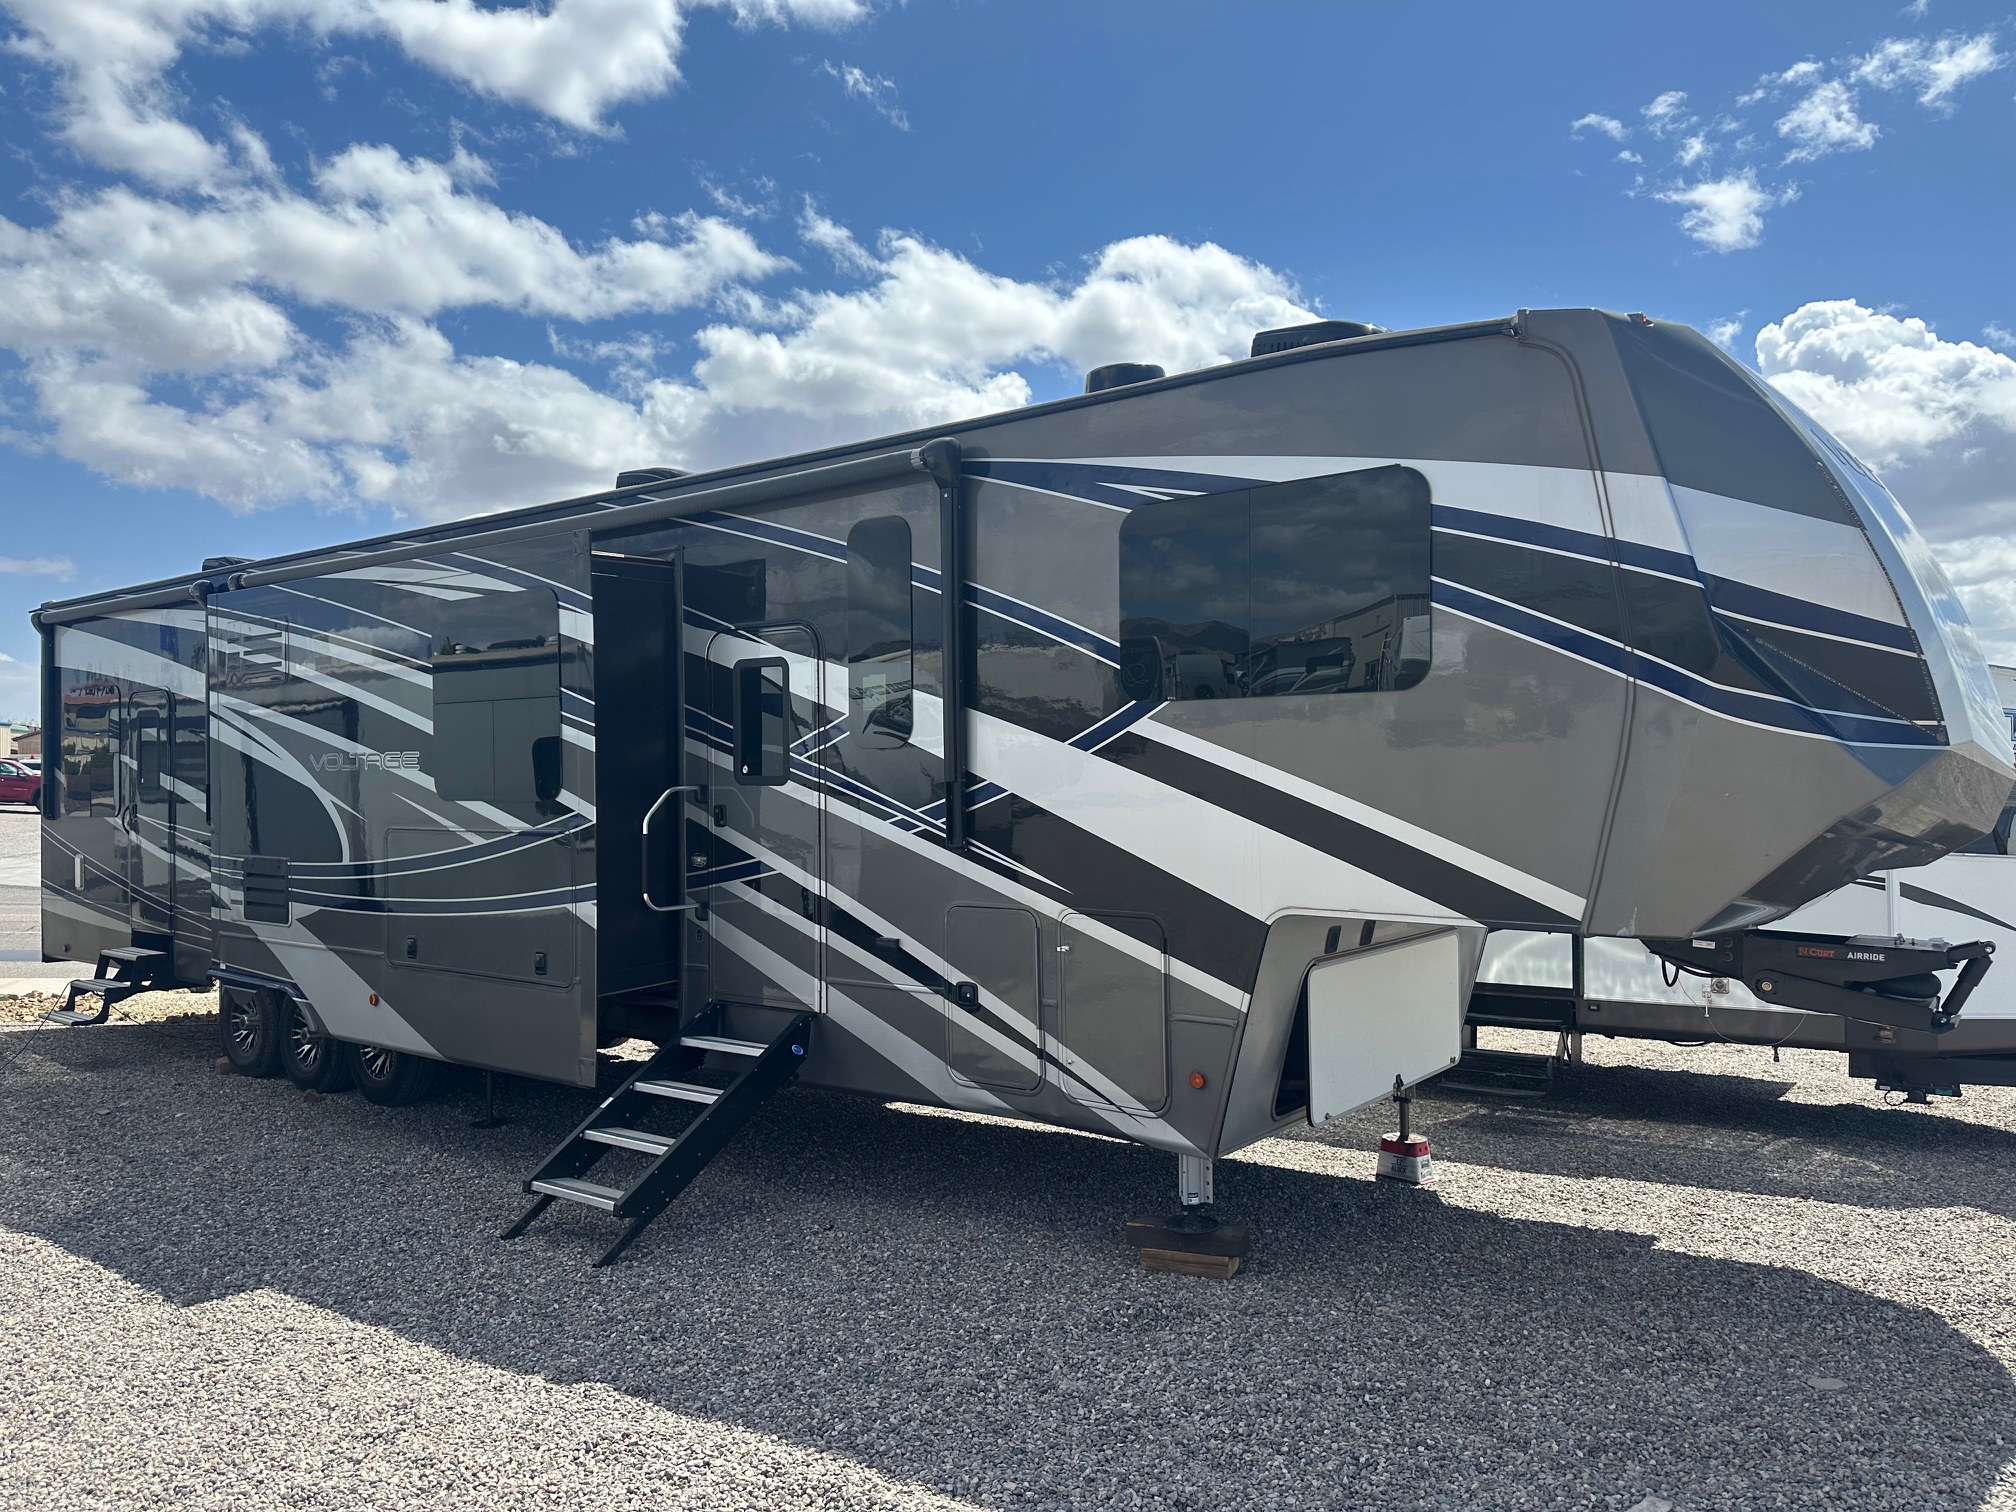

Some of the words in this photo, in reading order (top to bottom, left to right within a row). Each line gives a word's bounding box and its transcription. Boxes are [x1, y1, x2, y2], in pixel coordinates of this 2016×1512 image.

[309, 751, 420, 771] VOLTAGE
[1809, 948, 1835, 958] CURT
[1847, 951, 1886, 962] AIRRIDE
